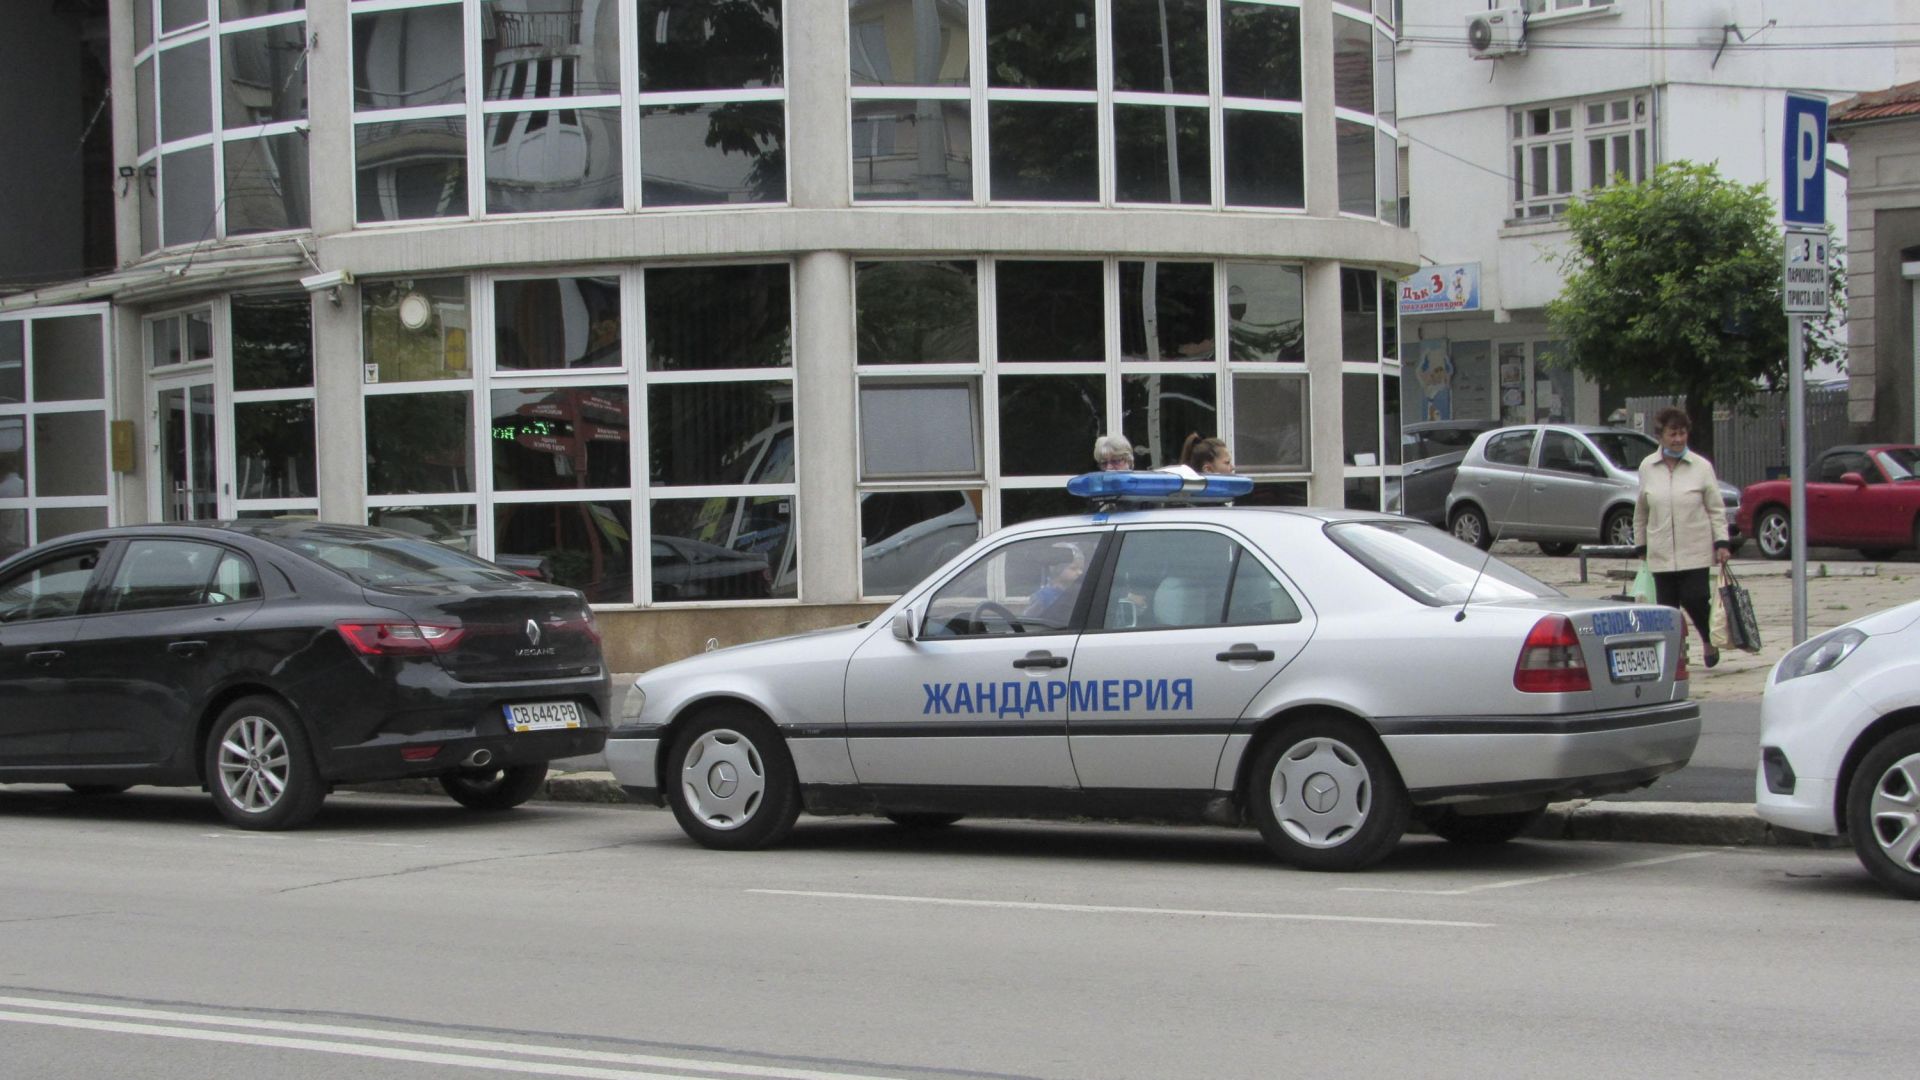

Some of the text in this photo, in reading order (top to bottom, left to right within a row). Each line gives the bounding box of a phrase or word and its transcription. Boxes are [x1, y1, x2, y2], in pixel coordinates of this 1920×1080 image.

[1796, 111, 1819, 212] P
[1803, 238, 1810, 262] 3
[1402, 273, 1444, 300] Дък 3
[1787, 267, 1825, 284] ПАРКОМЕСТА
[1787, 289, 1810, 306] ПРИСТА
[515, 647, 556, 657] MEGANE
[922, 678, 1194, 720] ЖАНДАРМЕРИЯ
[512, 704, 577, 724] CB 6442 PB
